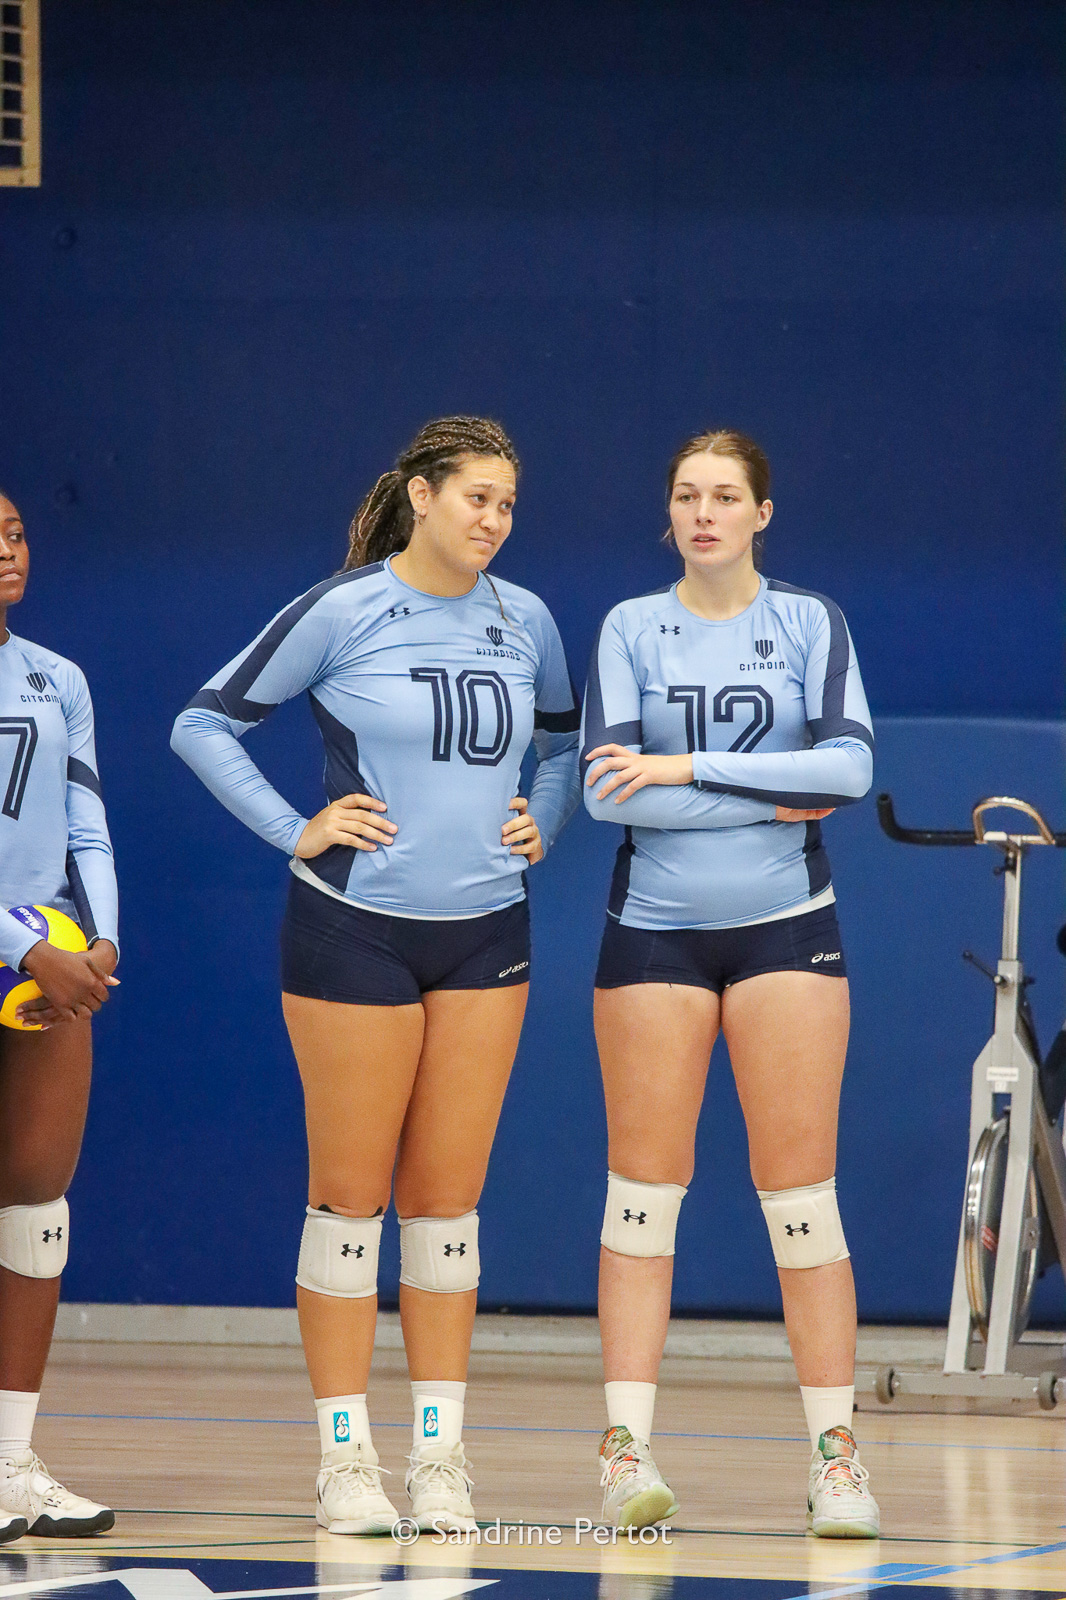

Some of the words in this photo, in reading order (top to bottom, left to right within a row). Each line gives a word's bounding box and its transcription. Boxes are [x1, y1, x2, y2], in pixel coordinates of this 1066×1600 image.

[739, 661, 790, 671] CITADIN
[408, 667, 513, 767] 10
[666, 685, 774, 753] 12
[0, 716, 39, 821] 7
